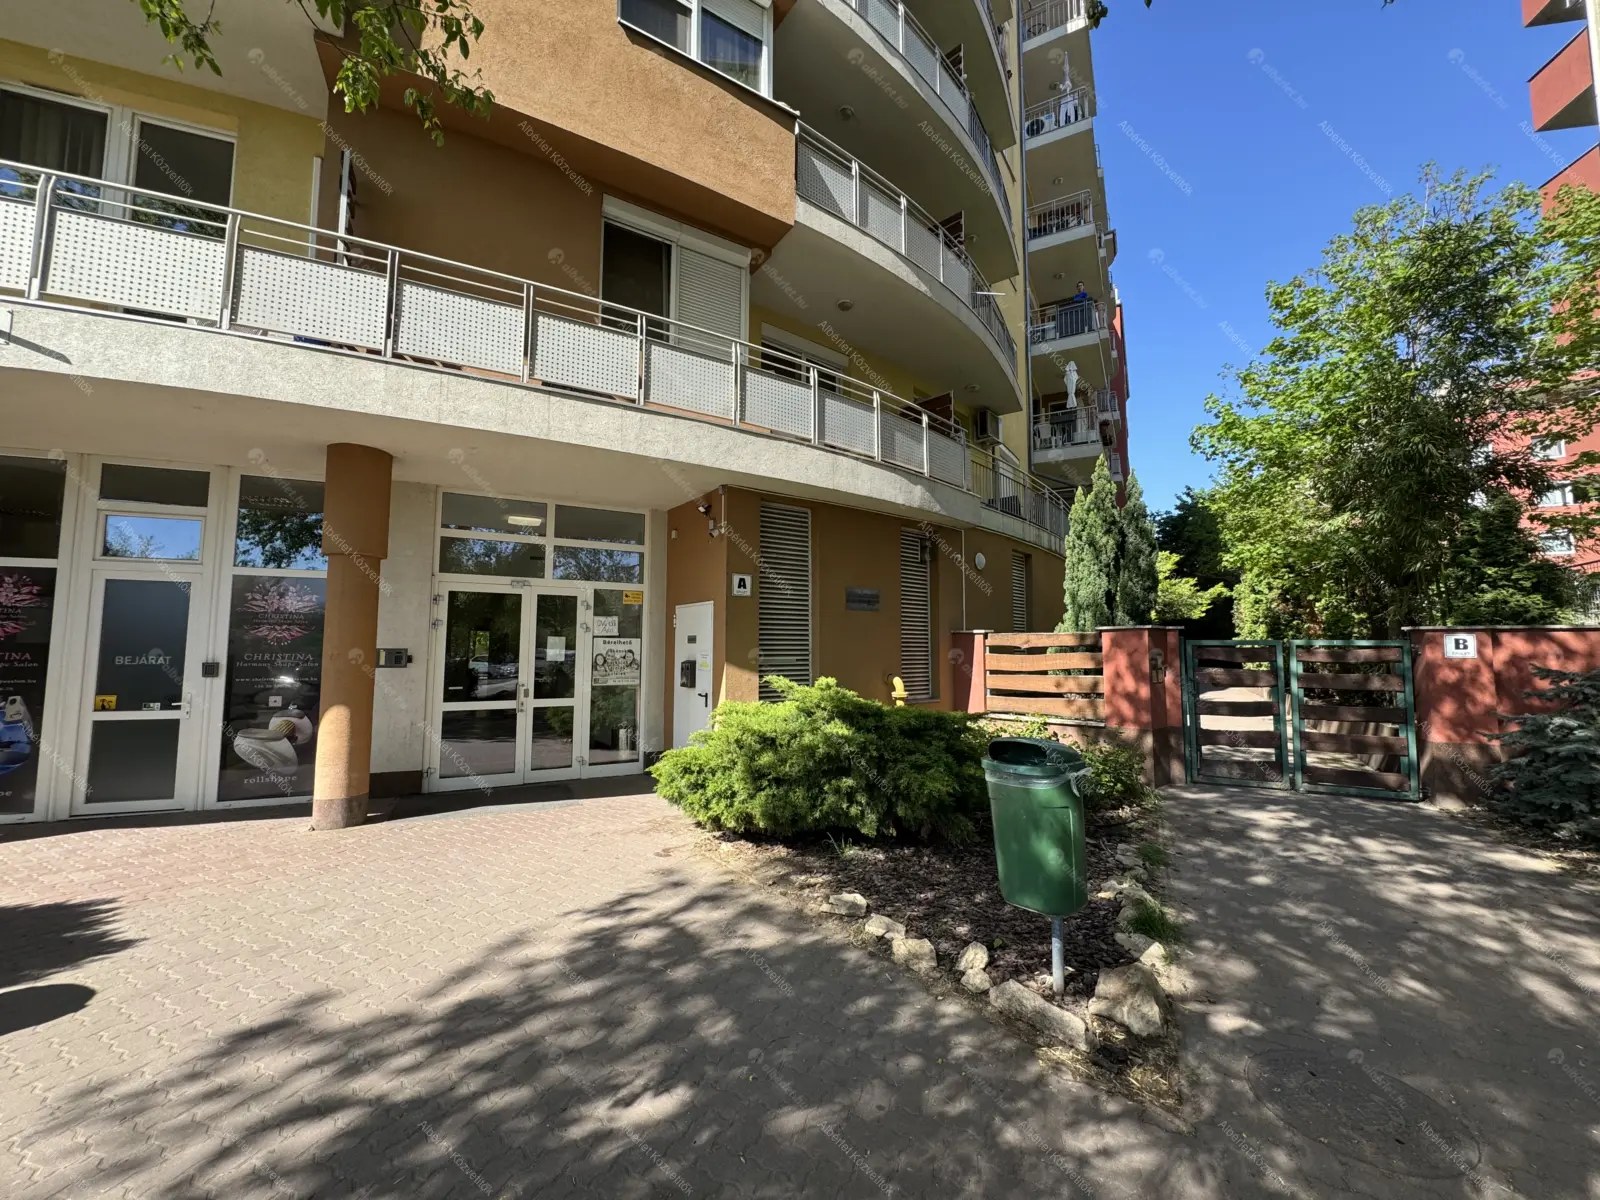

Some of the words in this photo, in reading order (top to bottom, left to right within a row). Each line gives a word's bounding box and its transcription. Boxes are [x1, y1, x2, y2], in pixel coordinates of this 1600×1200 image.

[737, 577, 747, 590] A
[1453, 637, 1469, 650] B
[115, 653, 172, 665] BEJÁRAT
